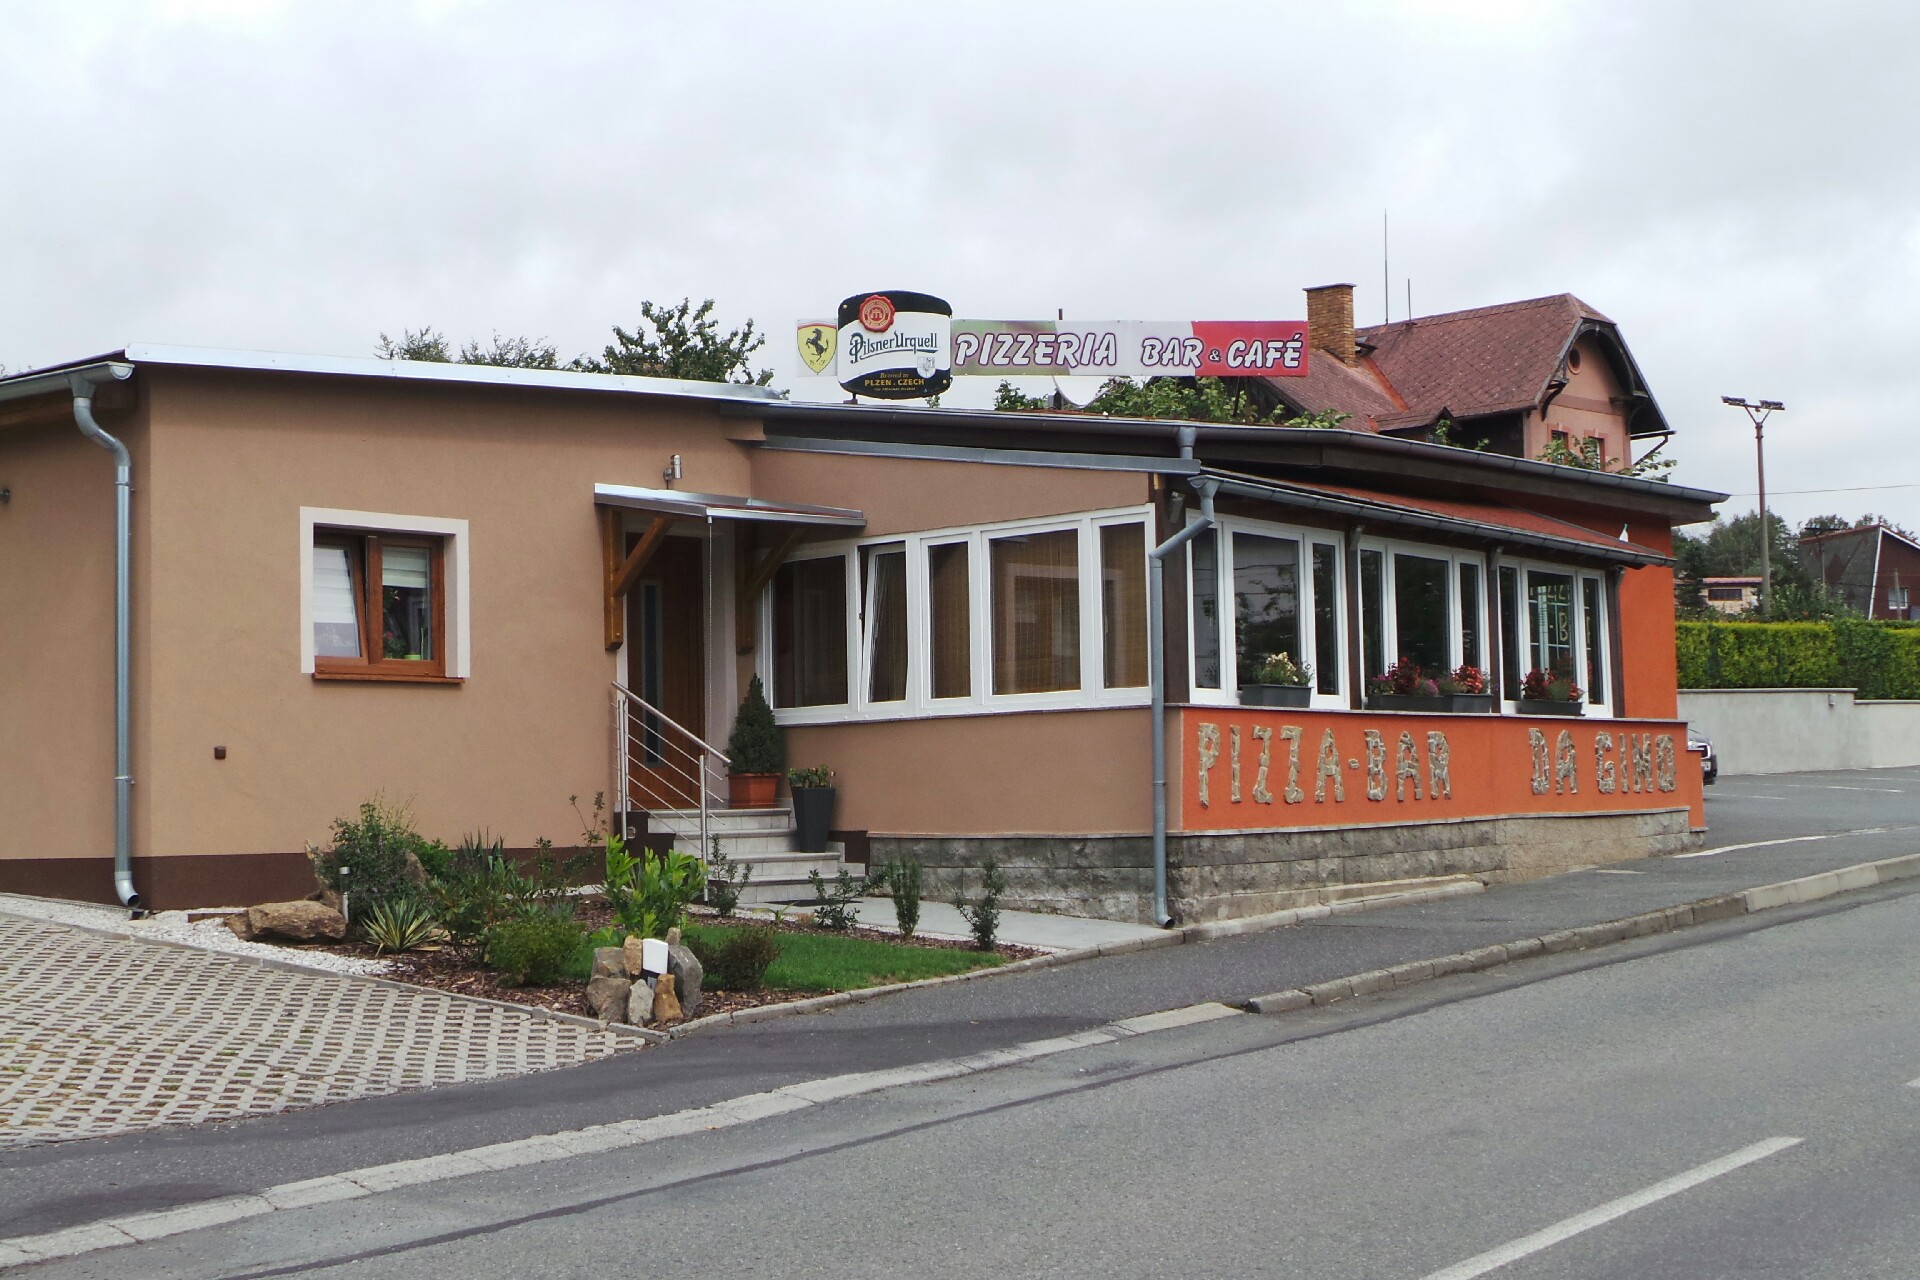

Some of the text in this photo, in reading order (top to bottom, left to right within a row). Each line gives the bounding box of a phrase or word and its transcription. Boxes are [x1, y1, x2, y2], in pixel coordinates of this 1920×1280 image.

[849, 330, 938, 364] Pilsner Urquell
[954, 332, 1303, 369] PIZZERIA BAR & CAFÉ
[897, 378, 925, 386] CZECH
[1528, 727, 1578, 795] DA
[1595, 731, 1677, 794] GINO
